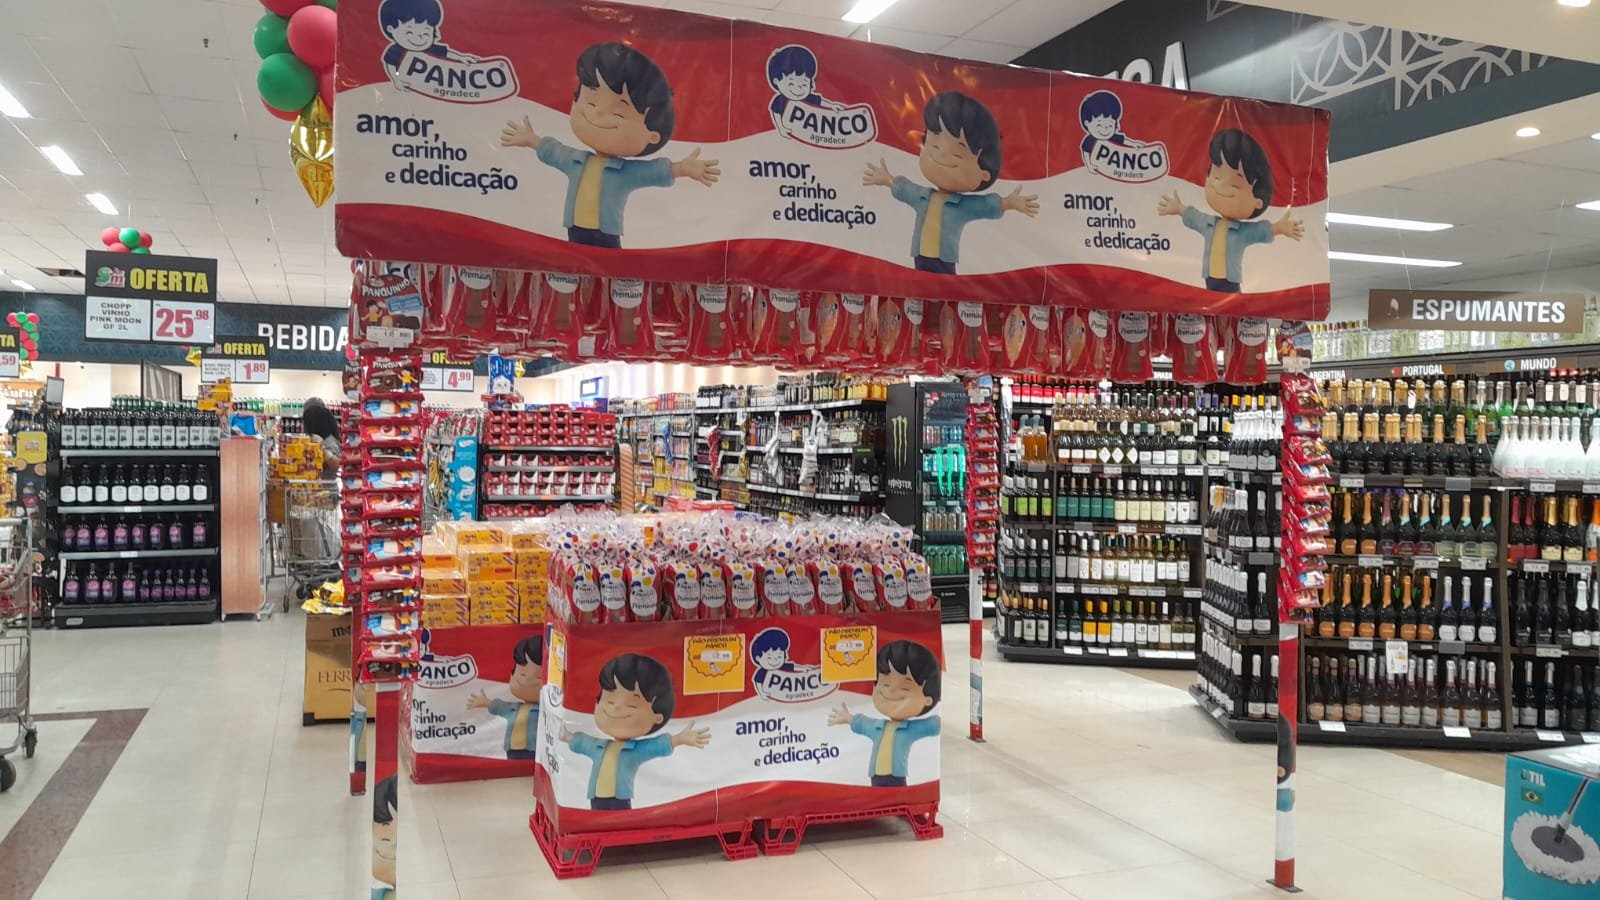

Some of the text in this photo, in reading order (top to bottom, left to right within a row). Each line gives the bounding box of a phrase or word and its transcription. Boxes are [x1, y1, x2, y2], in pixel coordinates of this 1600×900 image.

[406, 56, 507, 89] PANCO
[433, 88, 481, 98] agradece
[356, 112, 441, 142] amor,
[789, 106, 868, 136] PANCO
[810, 133, 846, 145] agradece
[391, 141, 467, 161] carinho
[1095, 144, 1163, 172] PANCO
[385, 162, 518, 195] e dedicação
[749, 159, 816, 184] amor,
[1113, 170, 1144, 179] agradece
[779, 181, 837, 200] carinho
[1063, 193, 1118, 214] amor,
[773, 201, 876, 230] e dedicação
[1087, 214, 1136, 230] carinho
[1085, 231, 1170, 255] e dedicação
[129, 267, 209, 294] OFERTA
[361, 278, 410, 297] PANQUINHO
[101, 302, 132, 310] CHOPP
[102, 309, 131, 317] VINHO
[1412, 298, 1566, 324] ESPUMANTES
[90, 315, 142, 325] PINK MOON
[224, 342, 266, 356] OFERTA
[1402, 364, 1444, 376] PORTUGAL
[1520, 357, 1557, 370] MUNDO
[318, 669, 351, 683] FERR
[415, 722, 476, 740] edicação
[736, 717, 788, 735] amor,
[759, 730, 806, 748] carinho
[754, 743, 840, 767] e dedicação
